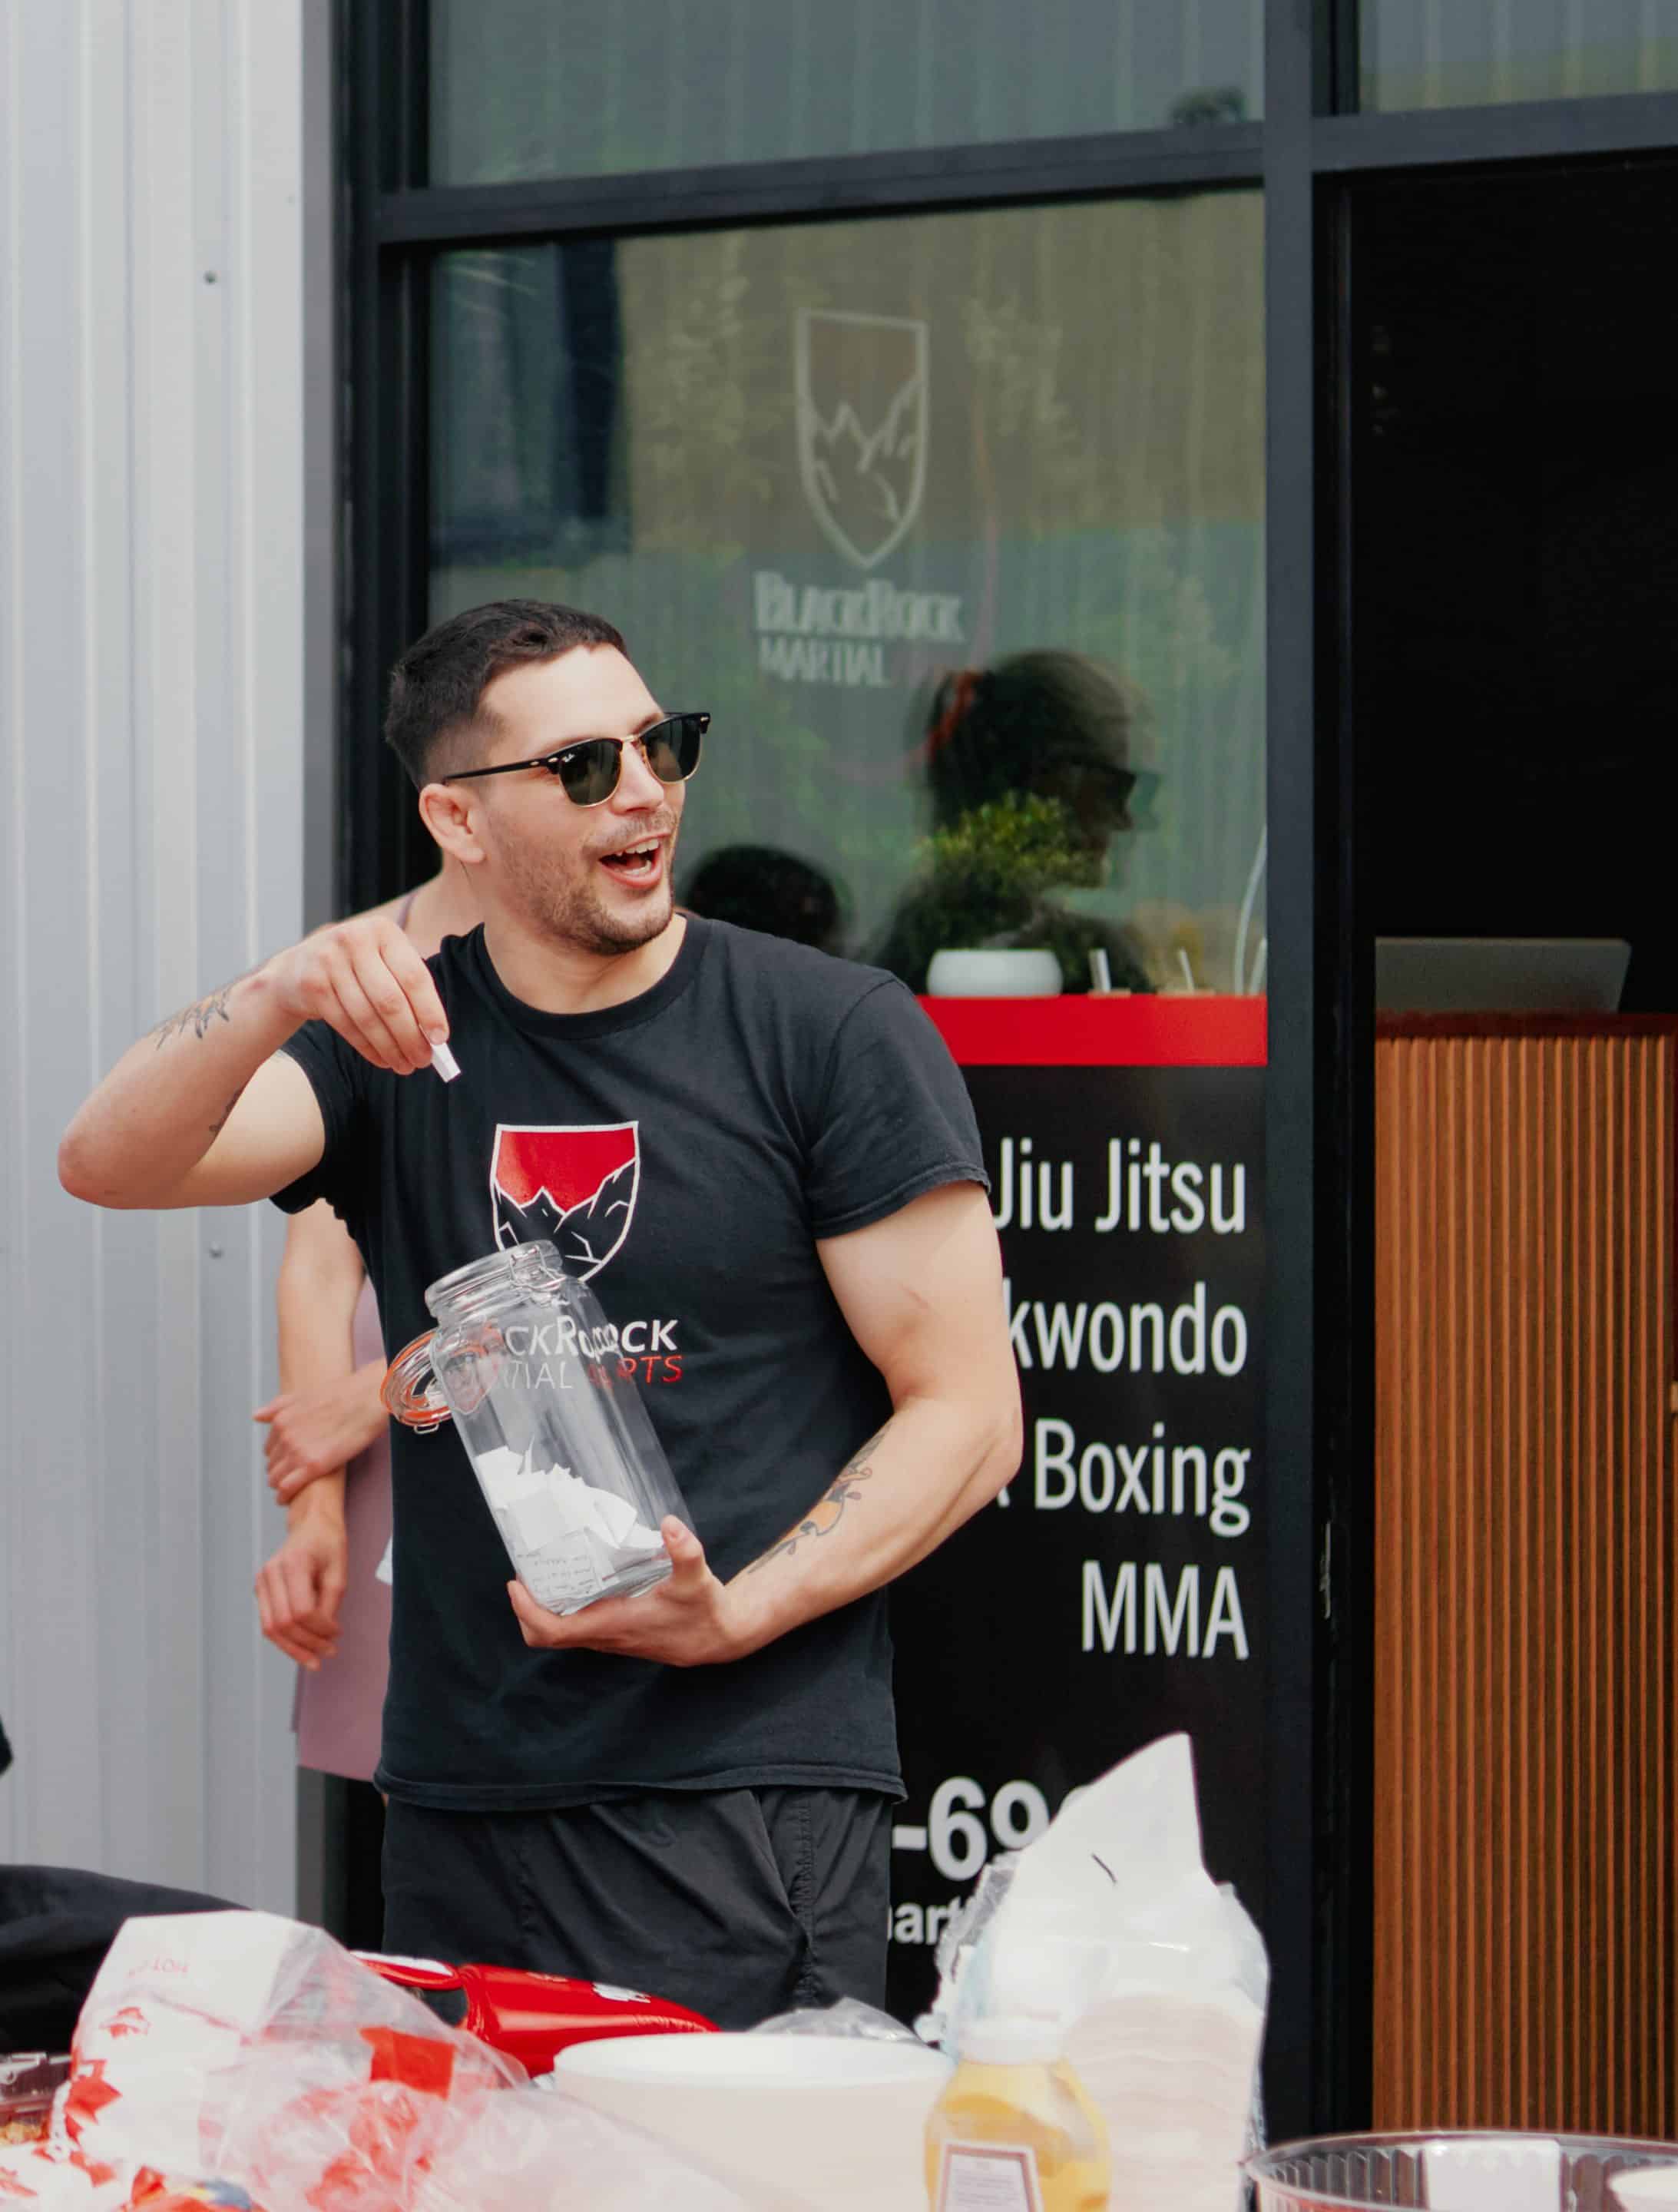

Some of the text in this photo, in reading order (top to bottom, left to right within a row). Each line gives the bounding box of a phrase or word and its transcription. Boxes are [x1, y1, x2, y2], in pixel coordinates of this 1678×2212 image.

[995, 1137, 1246, 1233] Jiu Jitsu
[503, 1359, 574, 1389] TIAL
[1002, 1277, 1248, 1376] kwondo
[1034, 1418, 1252, 1537] Boxing
[1081, 1560, 1249, 1660] MMA
